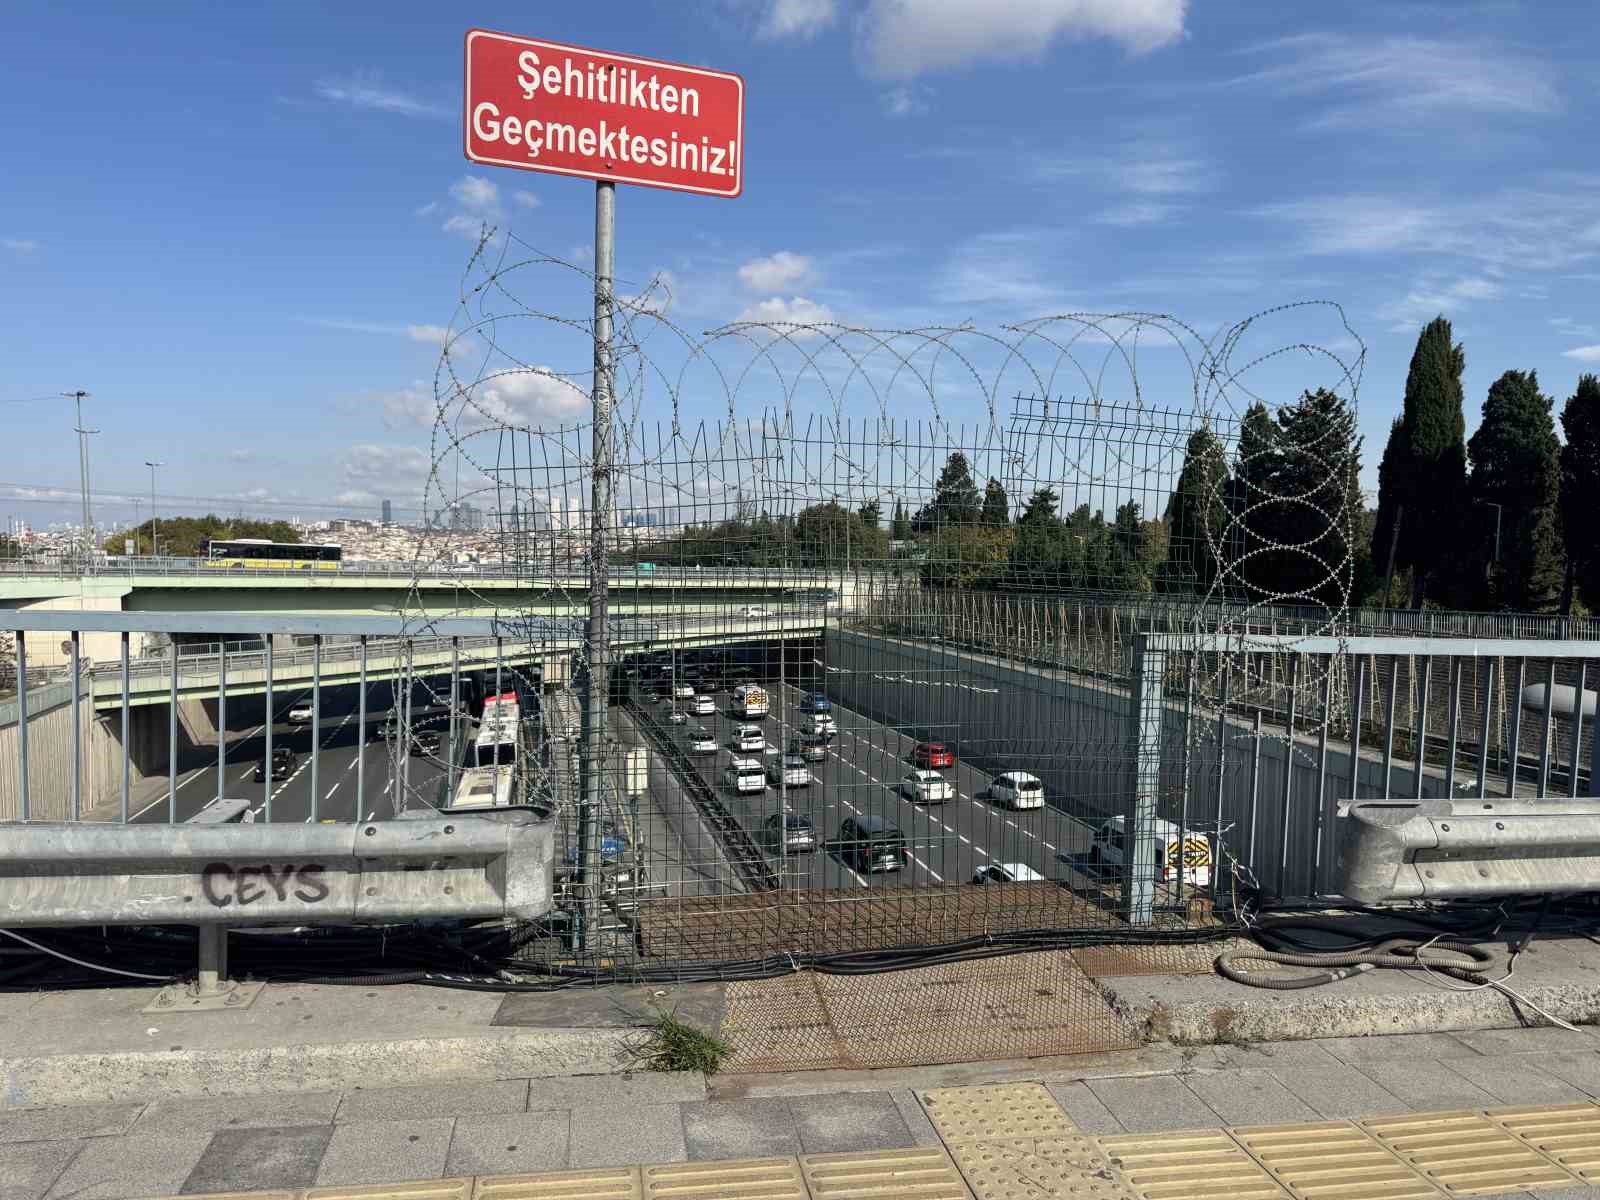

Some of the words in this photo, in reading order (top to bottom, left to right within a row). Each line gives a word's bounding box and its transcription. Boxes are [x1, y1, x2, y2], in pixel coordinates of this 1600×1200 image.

[517, 50, 699, 117] Şehitlikten
[473, 102, 735, 176] Geçmektesiniz!
[202, 862, 329, 908] CEYS
